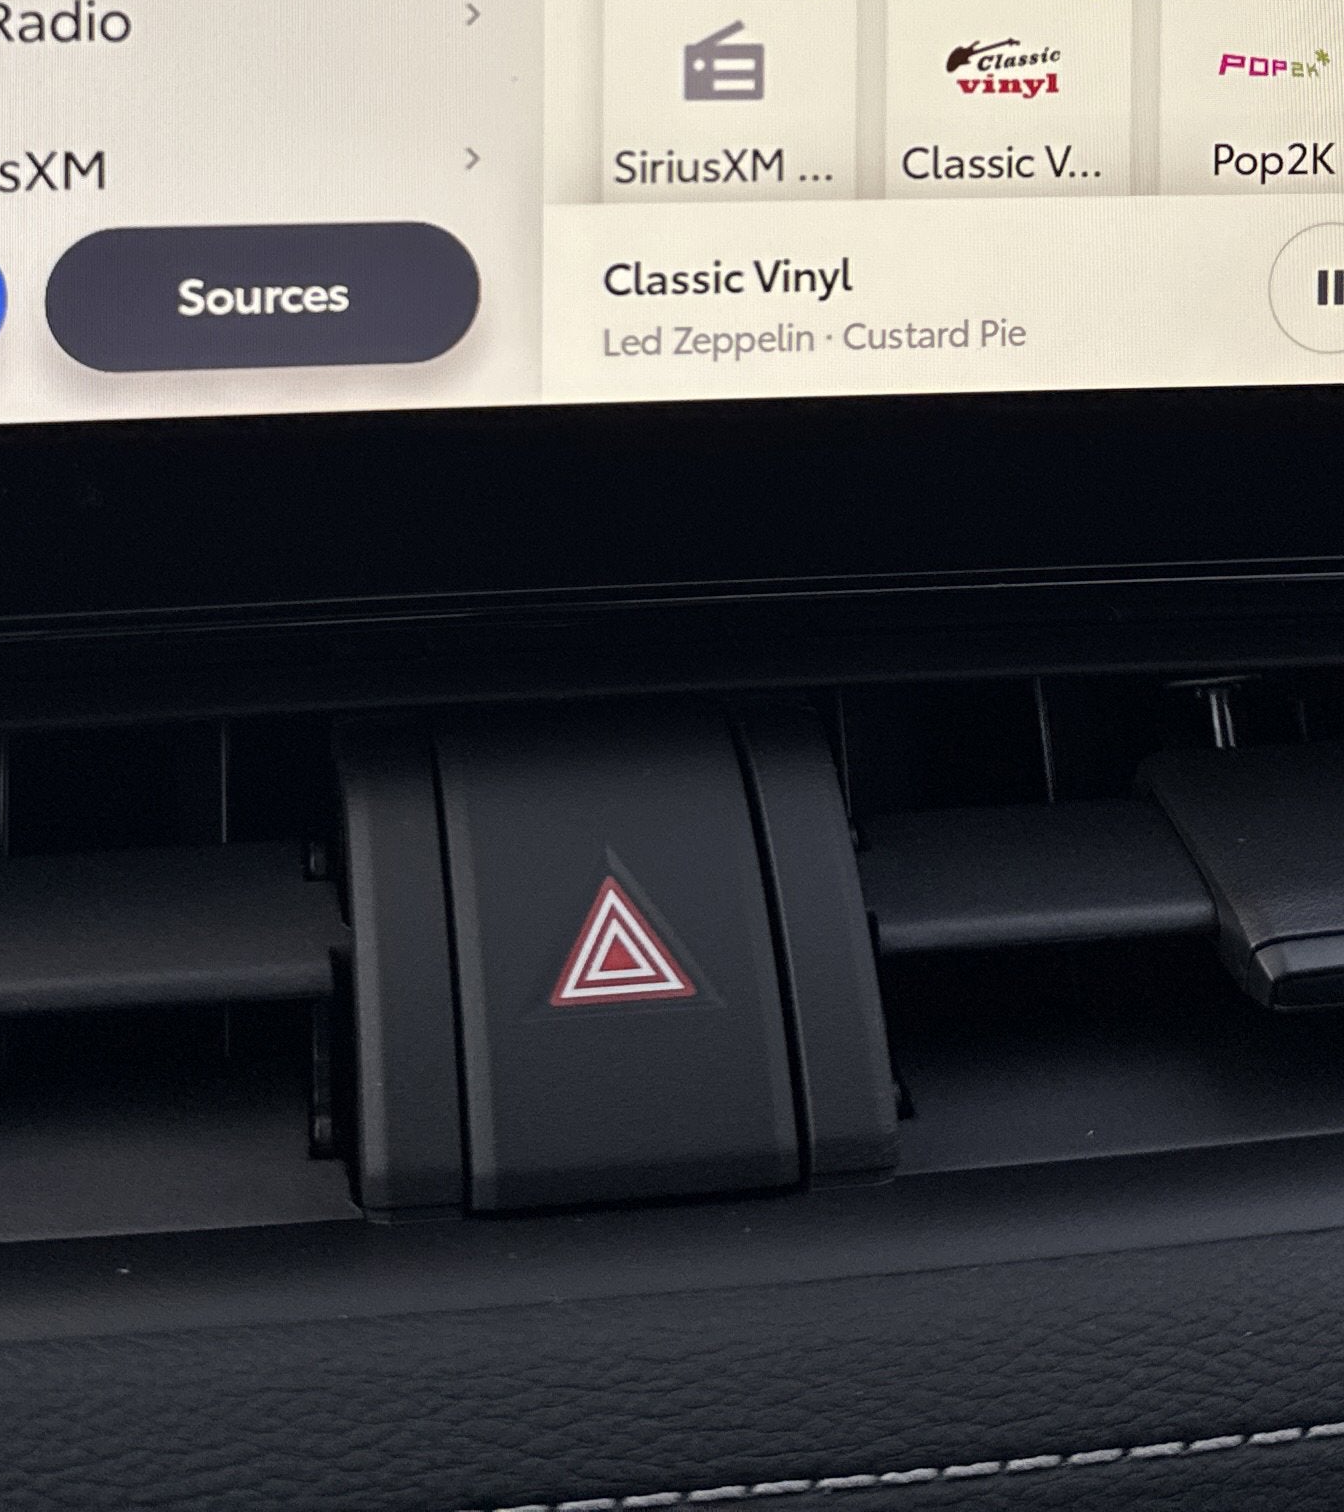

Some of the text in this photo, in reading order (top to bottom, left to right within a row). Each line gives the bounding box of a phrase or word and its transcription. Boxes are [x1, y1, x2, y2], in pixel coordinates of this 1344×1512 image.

[976, 46, 1061, 72] Classic
[956, 73, 1060, 99] vinyl
[613, 147, 785, 185] SiriusXM
[901, 143, 1102, 181] Classic V...
[1212, 141, 1336, 187] Pop2K
[177, 277, 351, 318] Sources
[602, 256, 854, 303] Classic Vinyl
[602, 316, 1028, 364] Led Zeppelin Custard Pie
